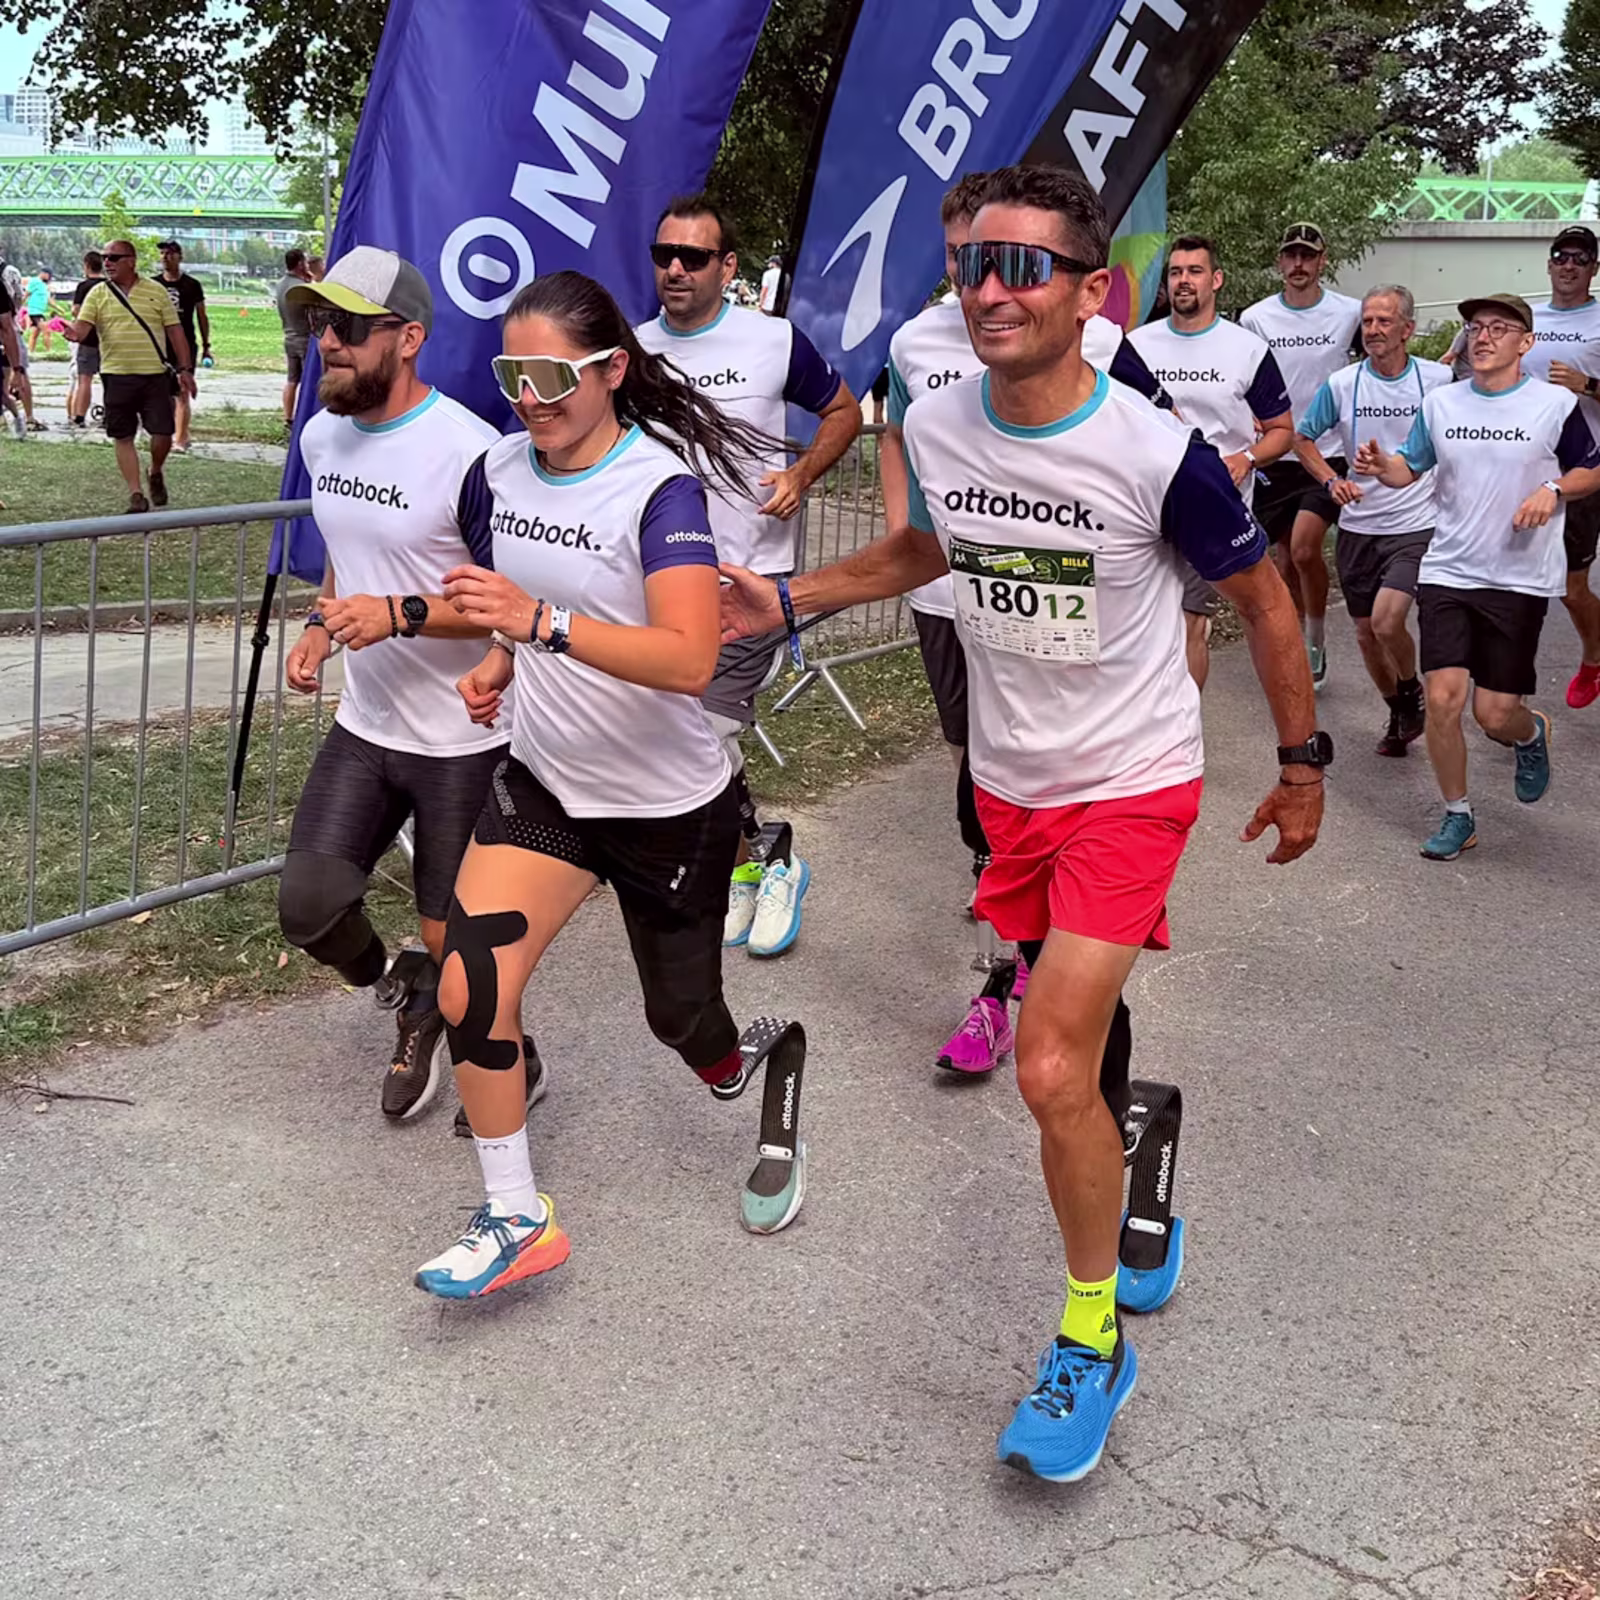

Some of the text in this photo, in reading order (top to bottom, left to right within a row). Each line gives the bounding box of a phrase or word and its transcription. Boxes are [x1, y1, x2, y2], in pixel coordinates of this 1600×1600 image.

[1268, 334, 1336, 348] ottobock.
[1154, 368, 1226, 383] ttobock.
[1445, 426, 1531, 442] ottobock.
[317, 472, 409, 510] ottobock.
[945, 487, 1105, 532] ottobock.
[492, 510, 602, 552] ottobock.
[1061, 556, 1089, 568] BILLA
[782, 1071, 797, 1130] ottobock.
[1156, 1140, 1173, 1203] ottobock.
